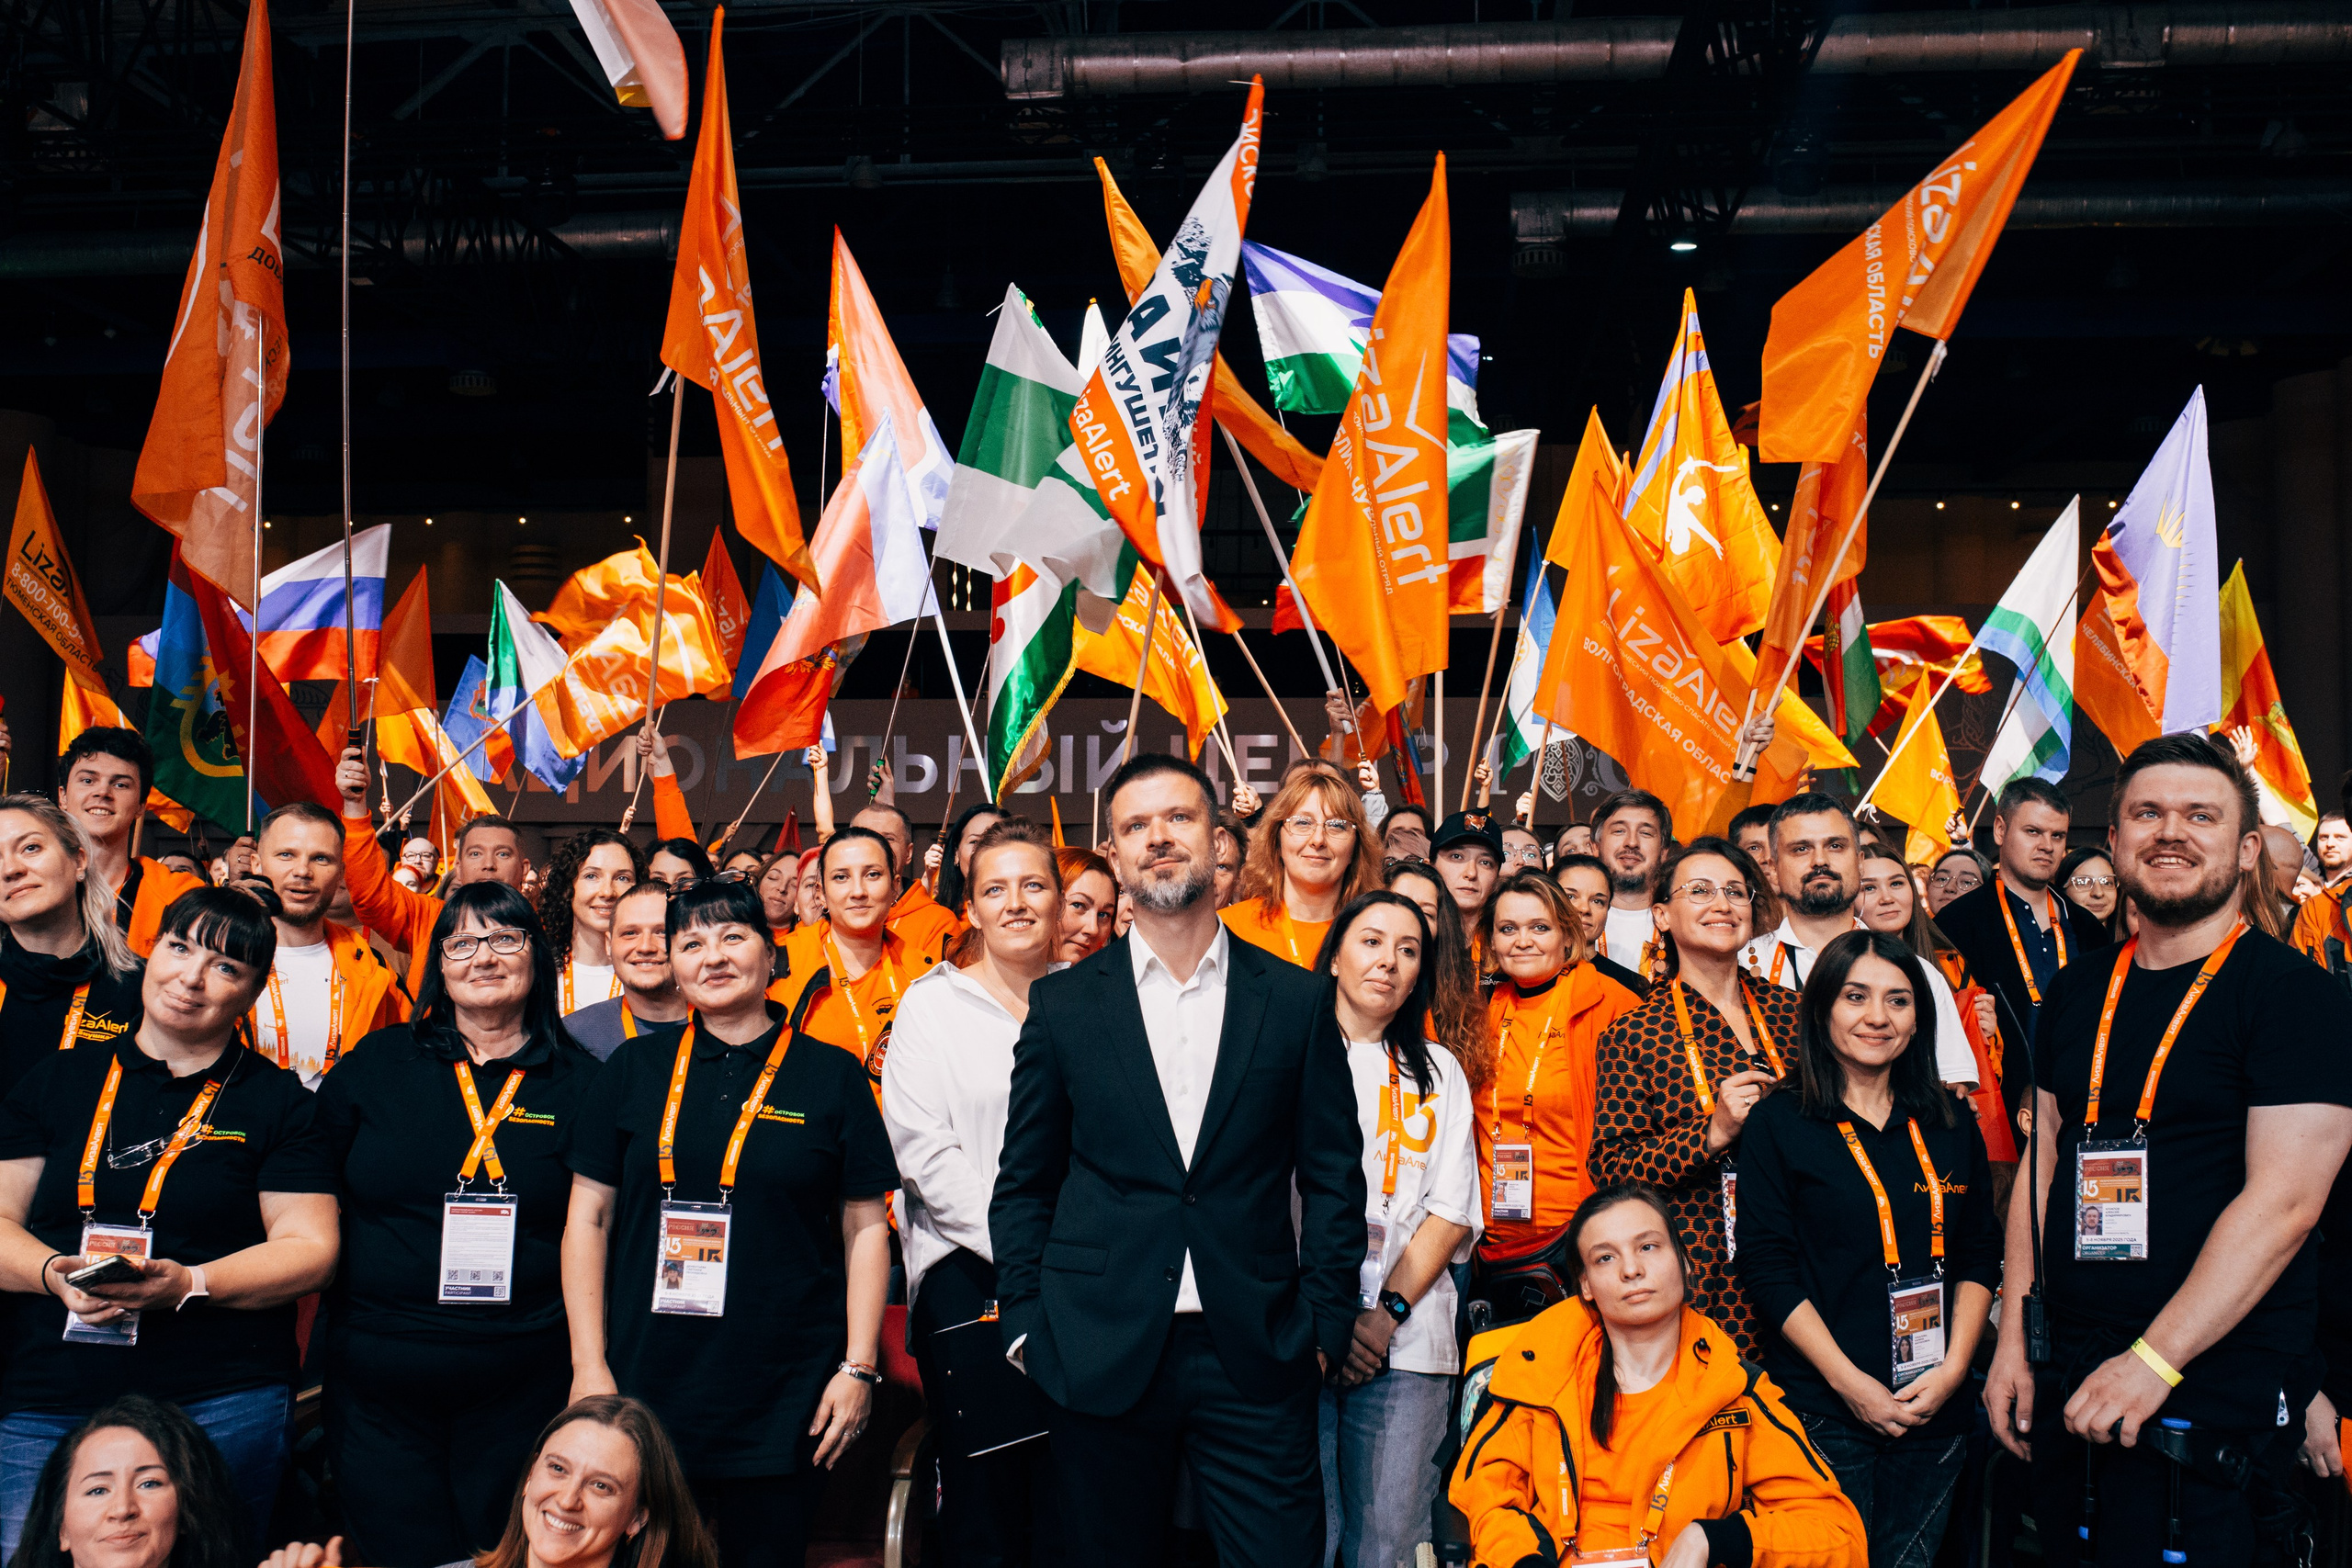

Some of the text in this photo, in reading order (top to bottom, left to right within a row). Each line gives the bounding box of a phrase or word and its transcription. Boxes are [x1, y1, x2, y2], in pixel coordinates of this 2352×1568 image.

[1866, 261, 1886, 359] ОБЛАСТЬ
[1071, 388, 1132, 502] izaAlert
[20, 529, 70, 597] Liza
[6, 576, 57, 634] ТЮМЕНСКАЯ
[1583, 636, 1731, 785] ВОЛГОГРАДСКАЯ ОБЛАС
[72, 1014, 130, 1035] zaAlert
[328, 1009, 339, 1047] ЛизаАлерт
[2168, 970, 2214, 1035] 15 ЛизаАлерт
[63, 1010, 83, 1050] ЛизаАлер
[1523, 1055, 1541, 1107] 15 ЛизаАлерт
[1681, 1033, 1704, 1086] 15 ЛизаАлерт
[2087, 1032, 2108, 1102] ЛизаАлерт 15
[201, 1080, 220, 1097] 15
[496, 1070, 523, 1111] ЛизаАлерт
[748, 1062, 779, 1114] 15 ЛизаАлерт
[1390, 1085, 1400, 1122] ЛизаАлерт
[658, 1100, 678, 1160] ЛизаАлерт 15
[757, 1112, 806, 1125] БЕЗОПАСНОСТИ
[76, 1122, 105, 1185] ЛизаАлерт 15
[1844, 1130, 1879, 1186] 15 ЛизаАлерт
[1927, 1171, 1944, 1236] ЛизаАлерт 15
[2083, 1179, 2099, 1198] 15
[665, 1236, 682, 1255] 15
[1896, 1314, 1910, 1331] 15
[1703, 1413, 1736, 1430] Alert
[1649, 1457, 1676, 1512] 15 Лиза
